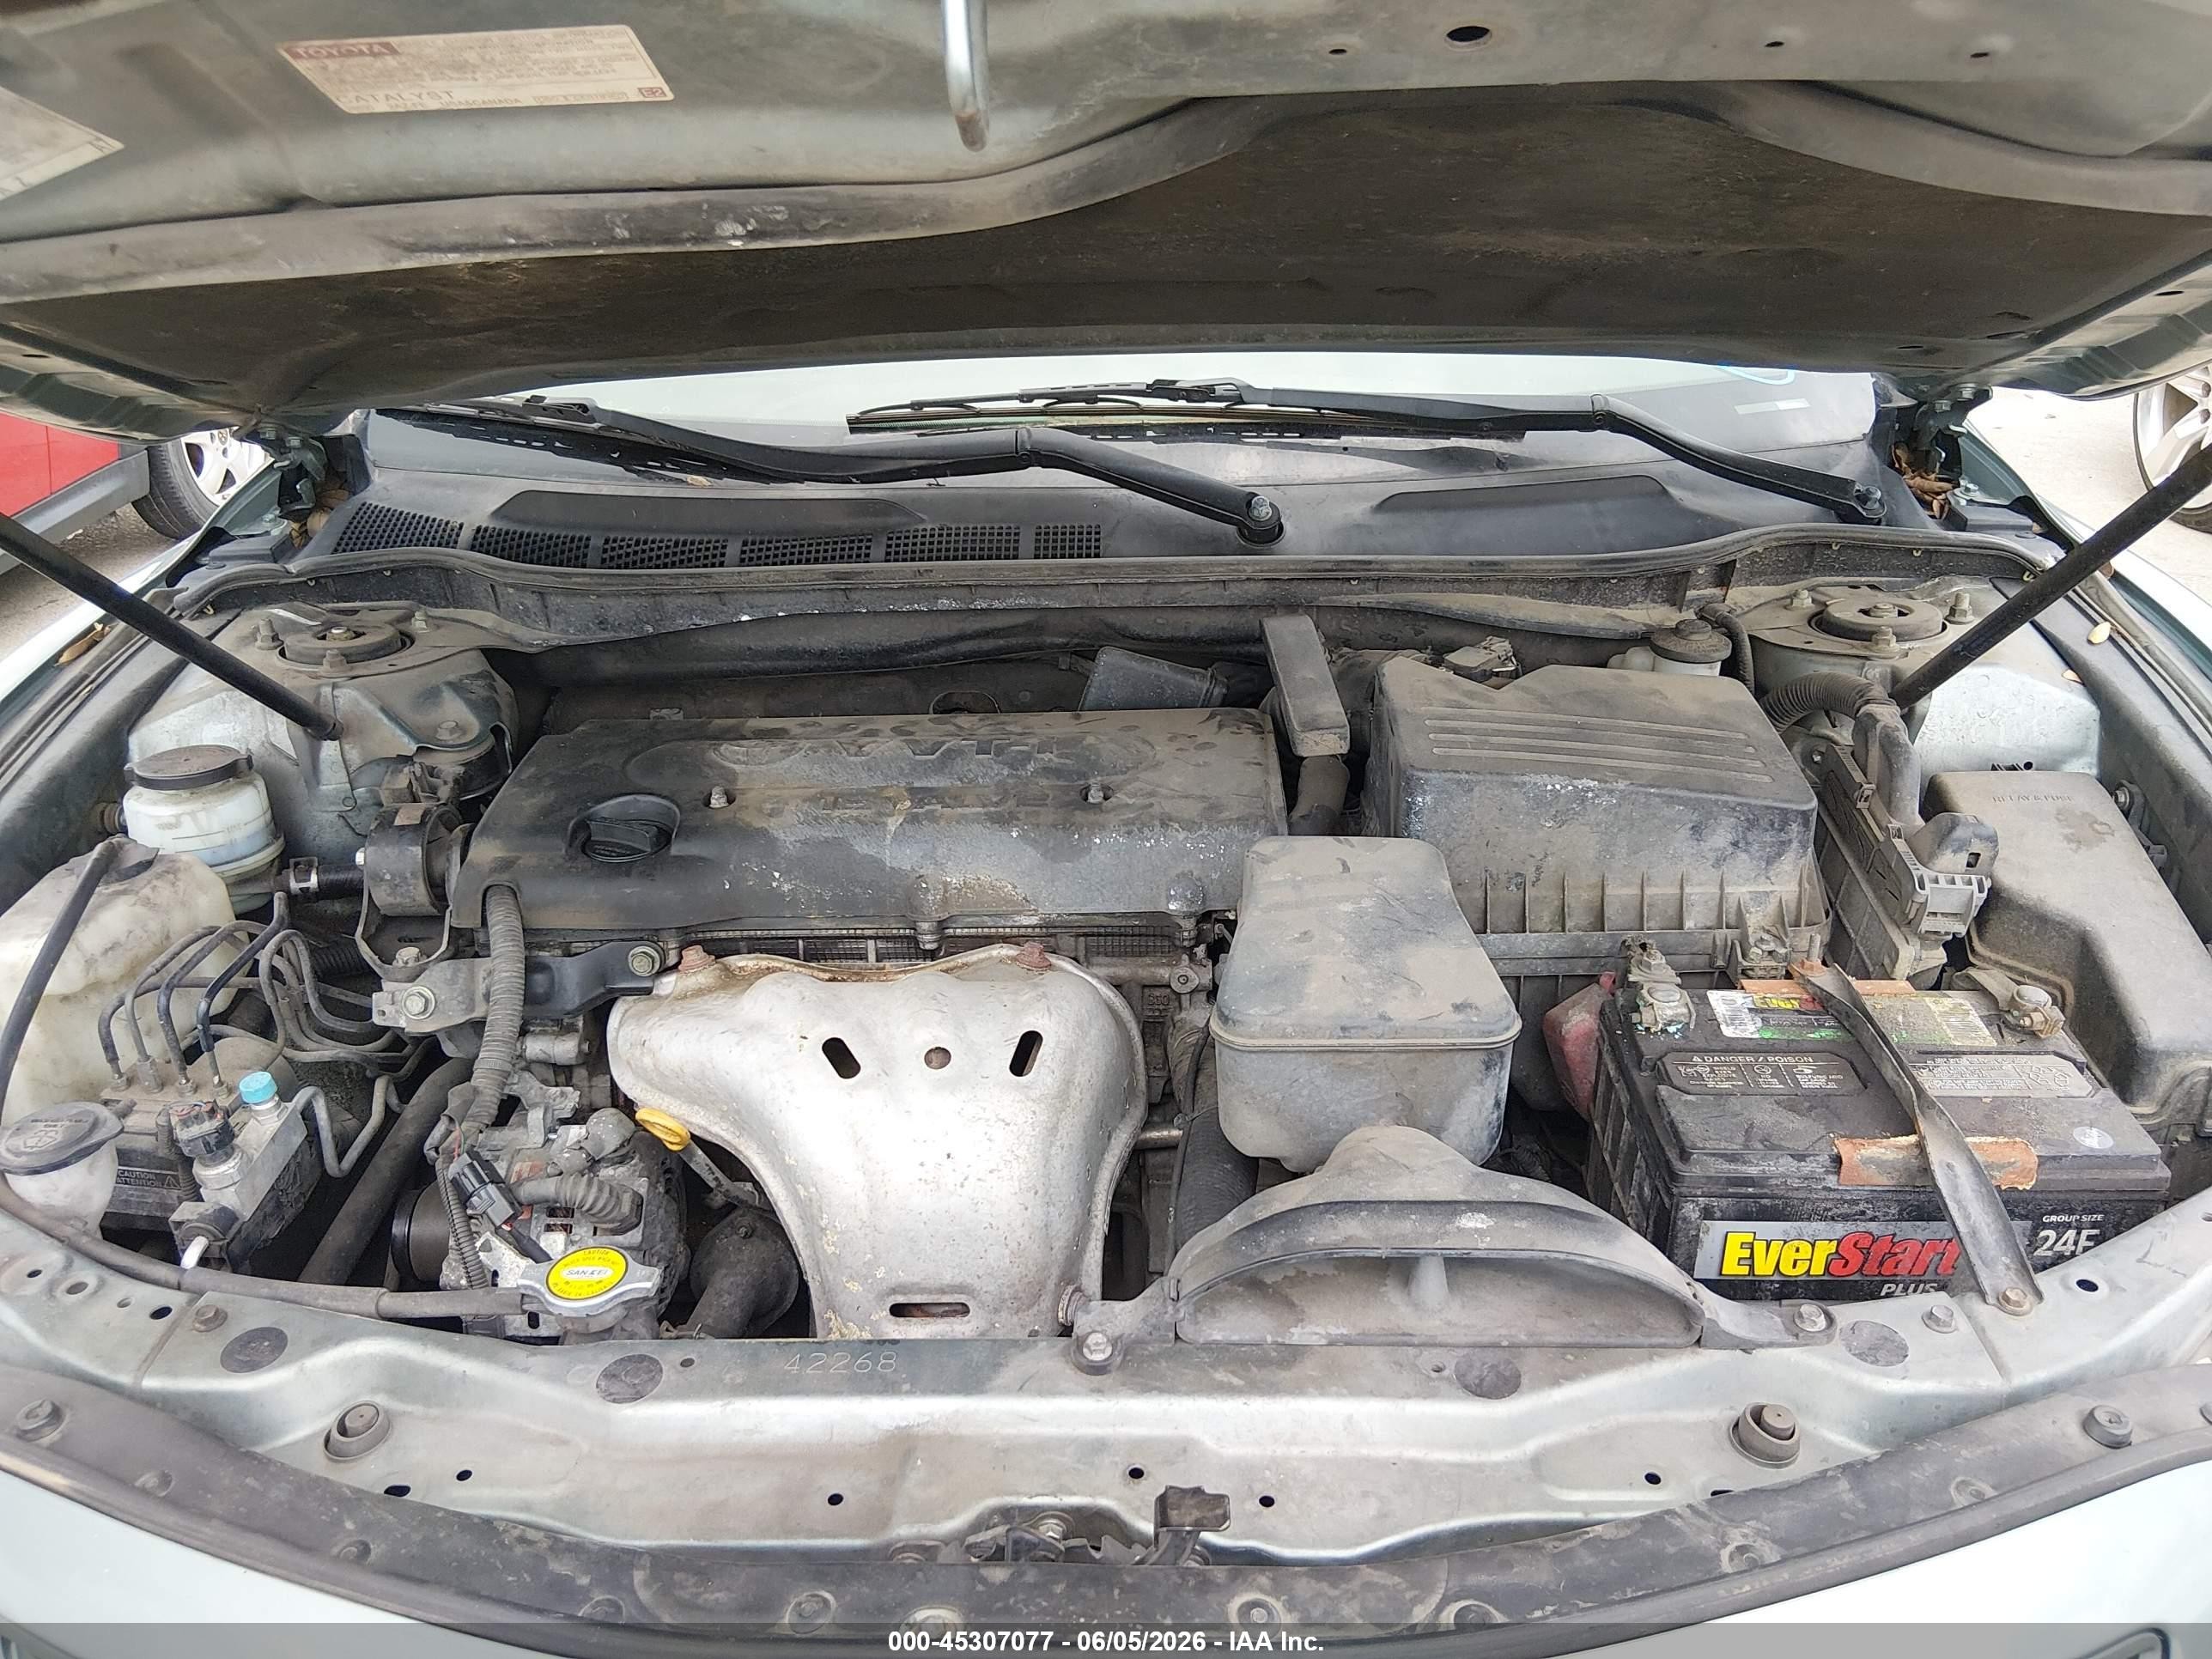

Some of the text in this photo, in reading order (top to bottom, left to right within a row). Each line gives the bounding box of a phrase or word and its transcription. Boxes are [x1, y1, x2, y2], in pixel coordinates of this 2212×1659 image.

[295, 44, 392, 58] TOYOTA
[337, 89, 454, 104] CATALYST
[116, 1177, 164, 1187] ATTENTION
[118, 1170, 155, 1180] CAUTION
[2033, 1229, 2100, 1256] 24F
[1720, 1231, 1962, 1278] EverStart
[1881, 1283, 1938, 1296] PLUS
[784, 1352, 897, 1374] 42268
